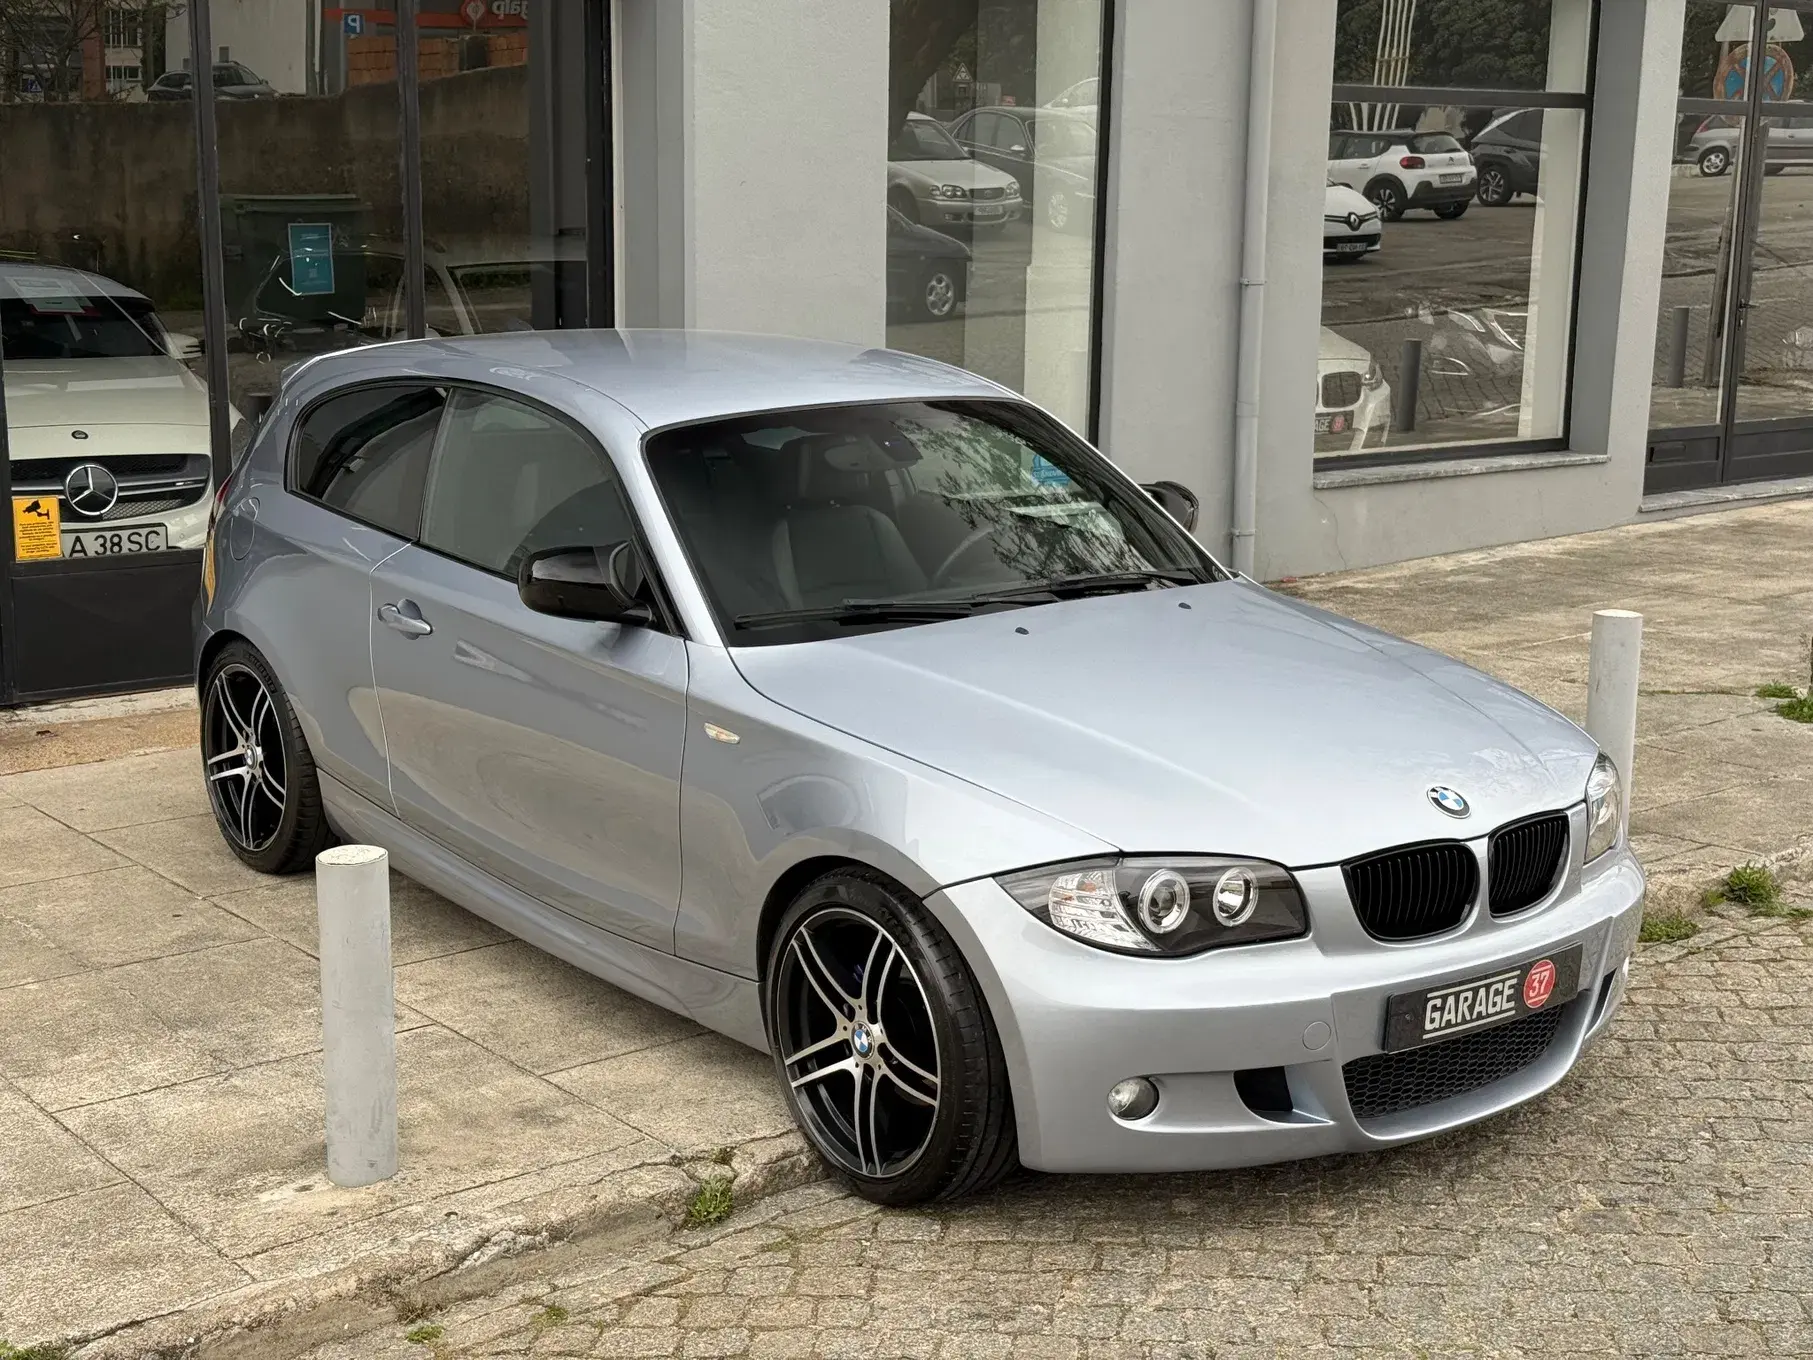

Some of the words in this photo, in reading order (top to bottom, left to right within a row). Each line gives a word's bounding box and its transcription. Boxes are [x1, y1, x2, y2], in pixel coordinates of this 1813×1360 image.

[62, 535, 88, 557] A
[94, 533, 123, 556] 38
[127, 529, 161, 553] SC
[1424, 978, 1518, 1031] GARAGE
[1529, 970, 1550, 997] 37
